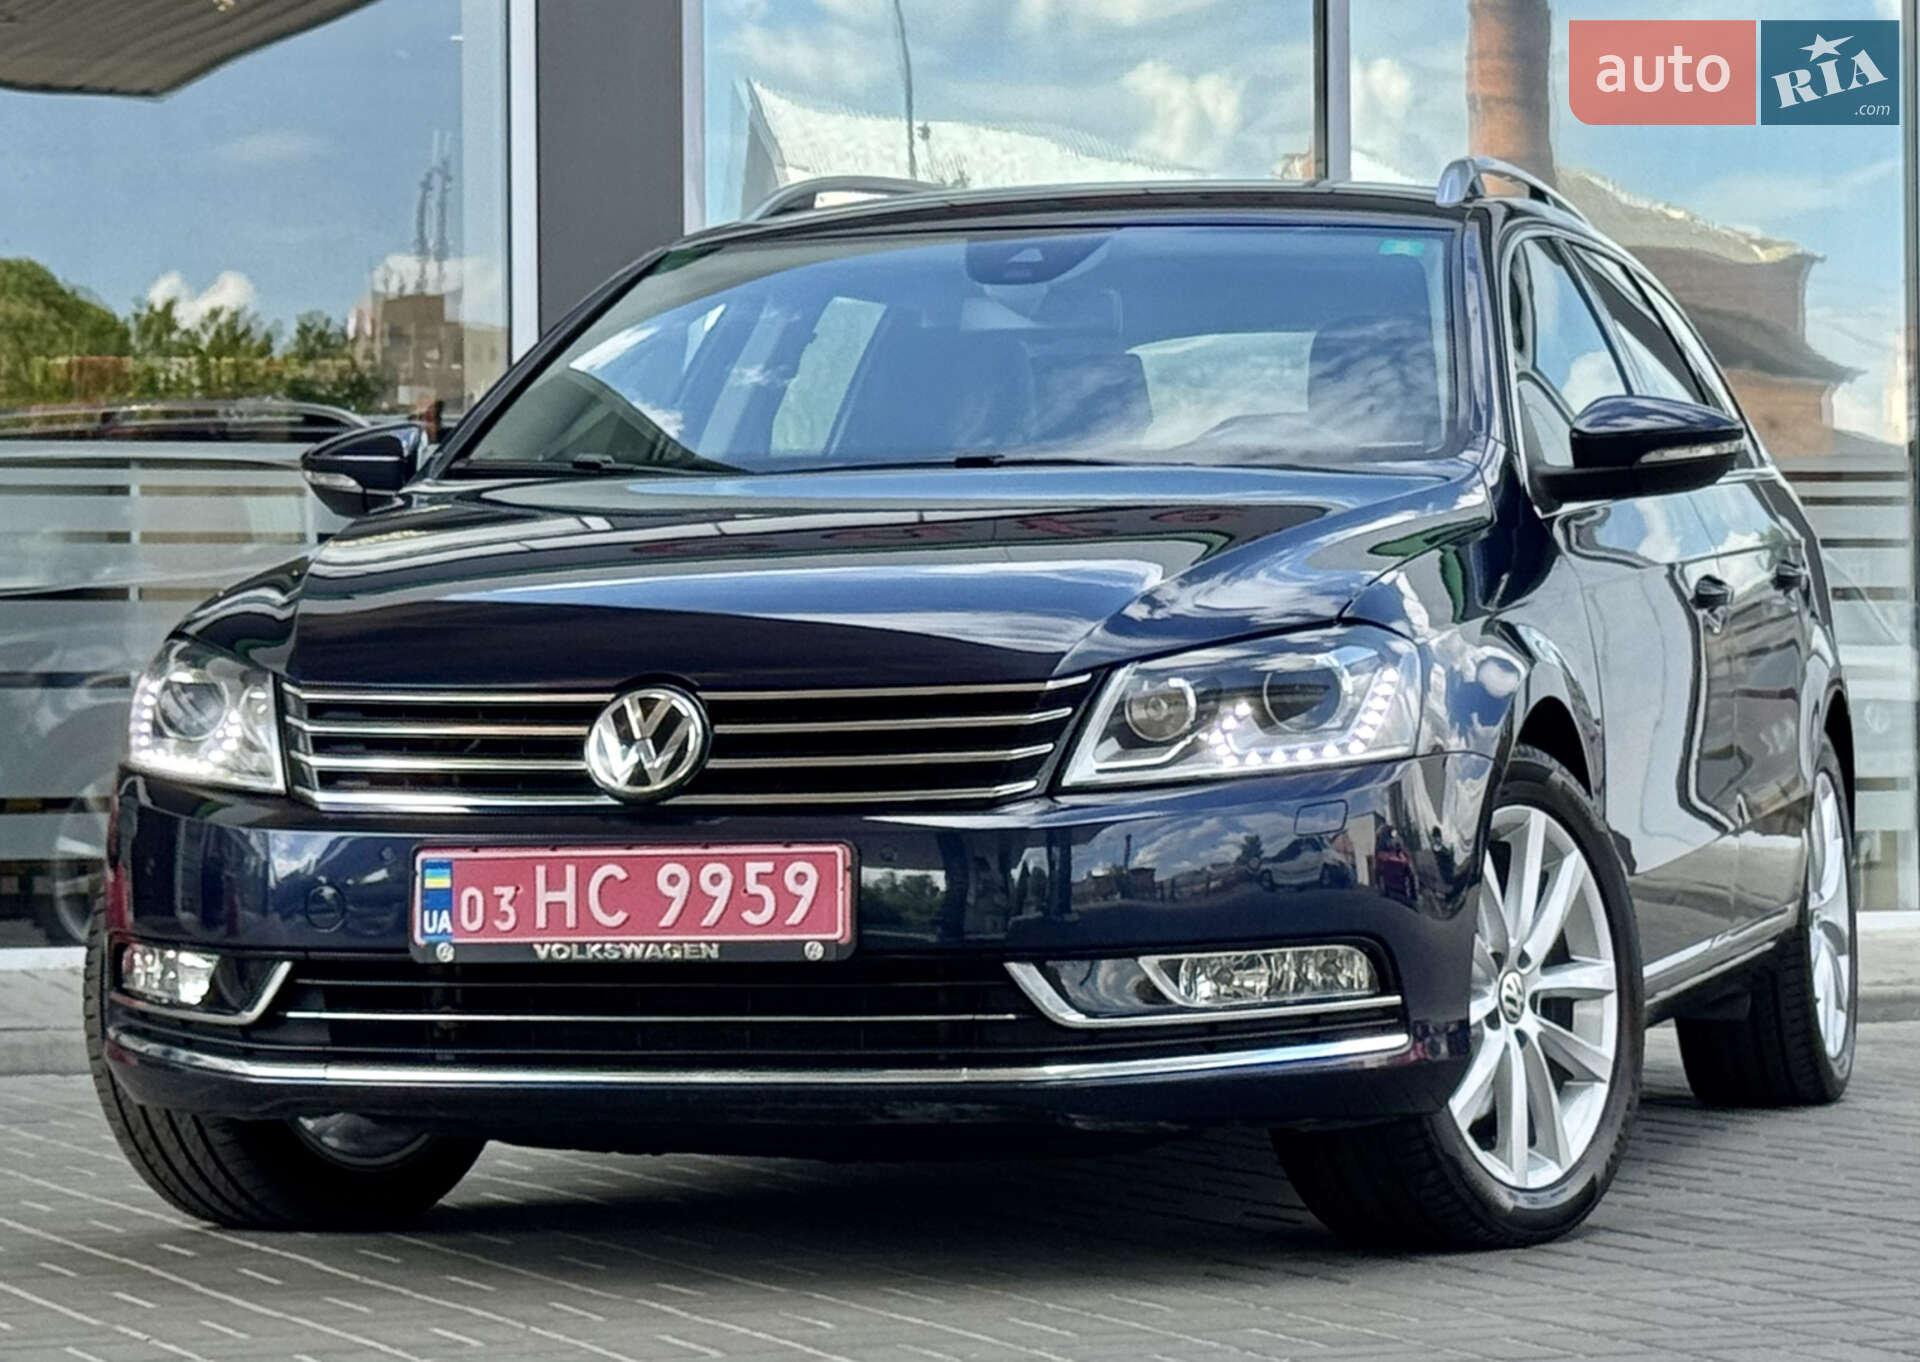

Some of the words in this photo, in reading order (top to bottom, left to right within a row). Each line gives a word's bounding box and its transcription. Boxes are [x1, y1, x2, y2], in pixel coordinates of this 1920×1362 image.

[460, 886, 517, 932] 03
[535, 863, 630, 929] HC
[656, 861, 819, 928] 9959
[423, 909, 453, 934] UA
[533, 942, 720, 961] VOLKSWAGEN
